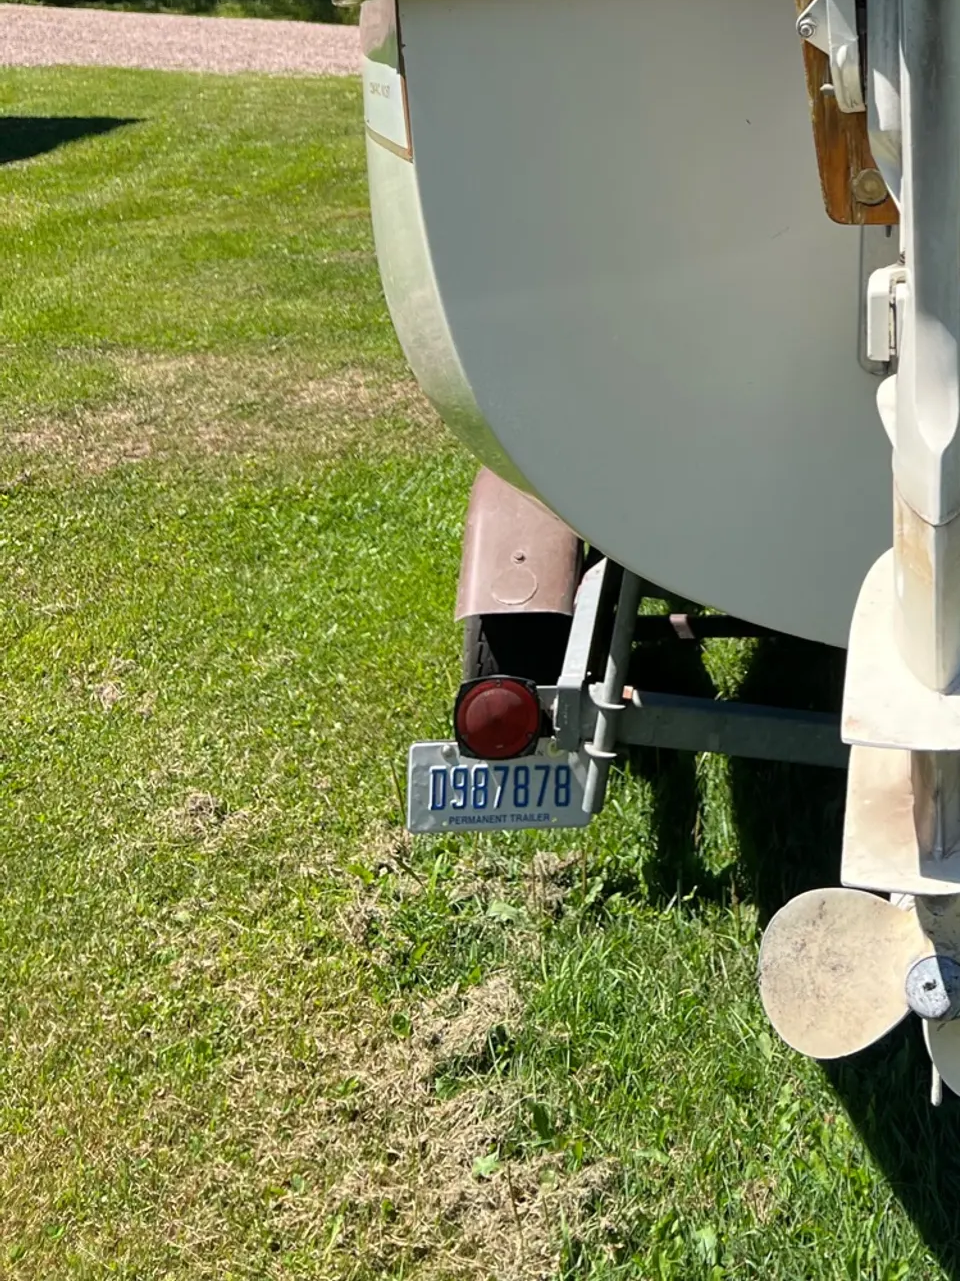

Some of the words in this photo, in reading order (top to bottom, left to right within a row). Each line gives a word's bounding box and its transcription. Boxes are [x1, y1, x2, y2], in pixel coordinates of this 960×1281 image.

[428, 764, 571, 810] D987878
[448, 814, 507, 825] PERMANENT
[509, 813, 550, 822] TRAILER
